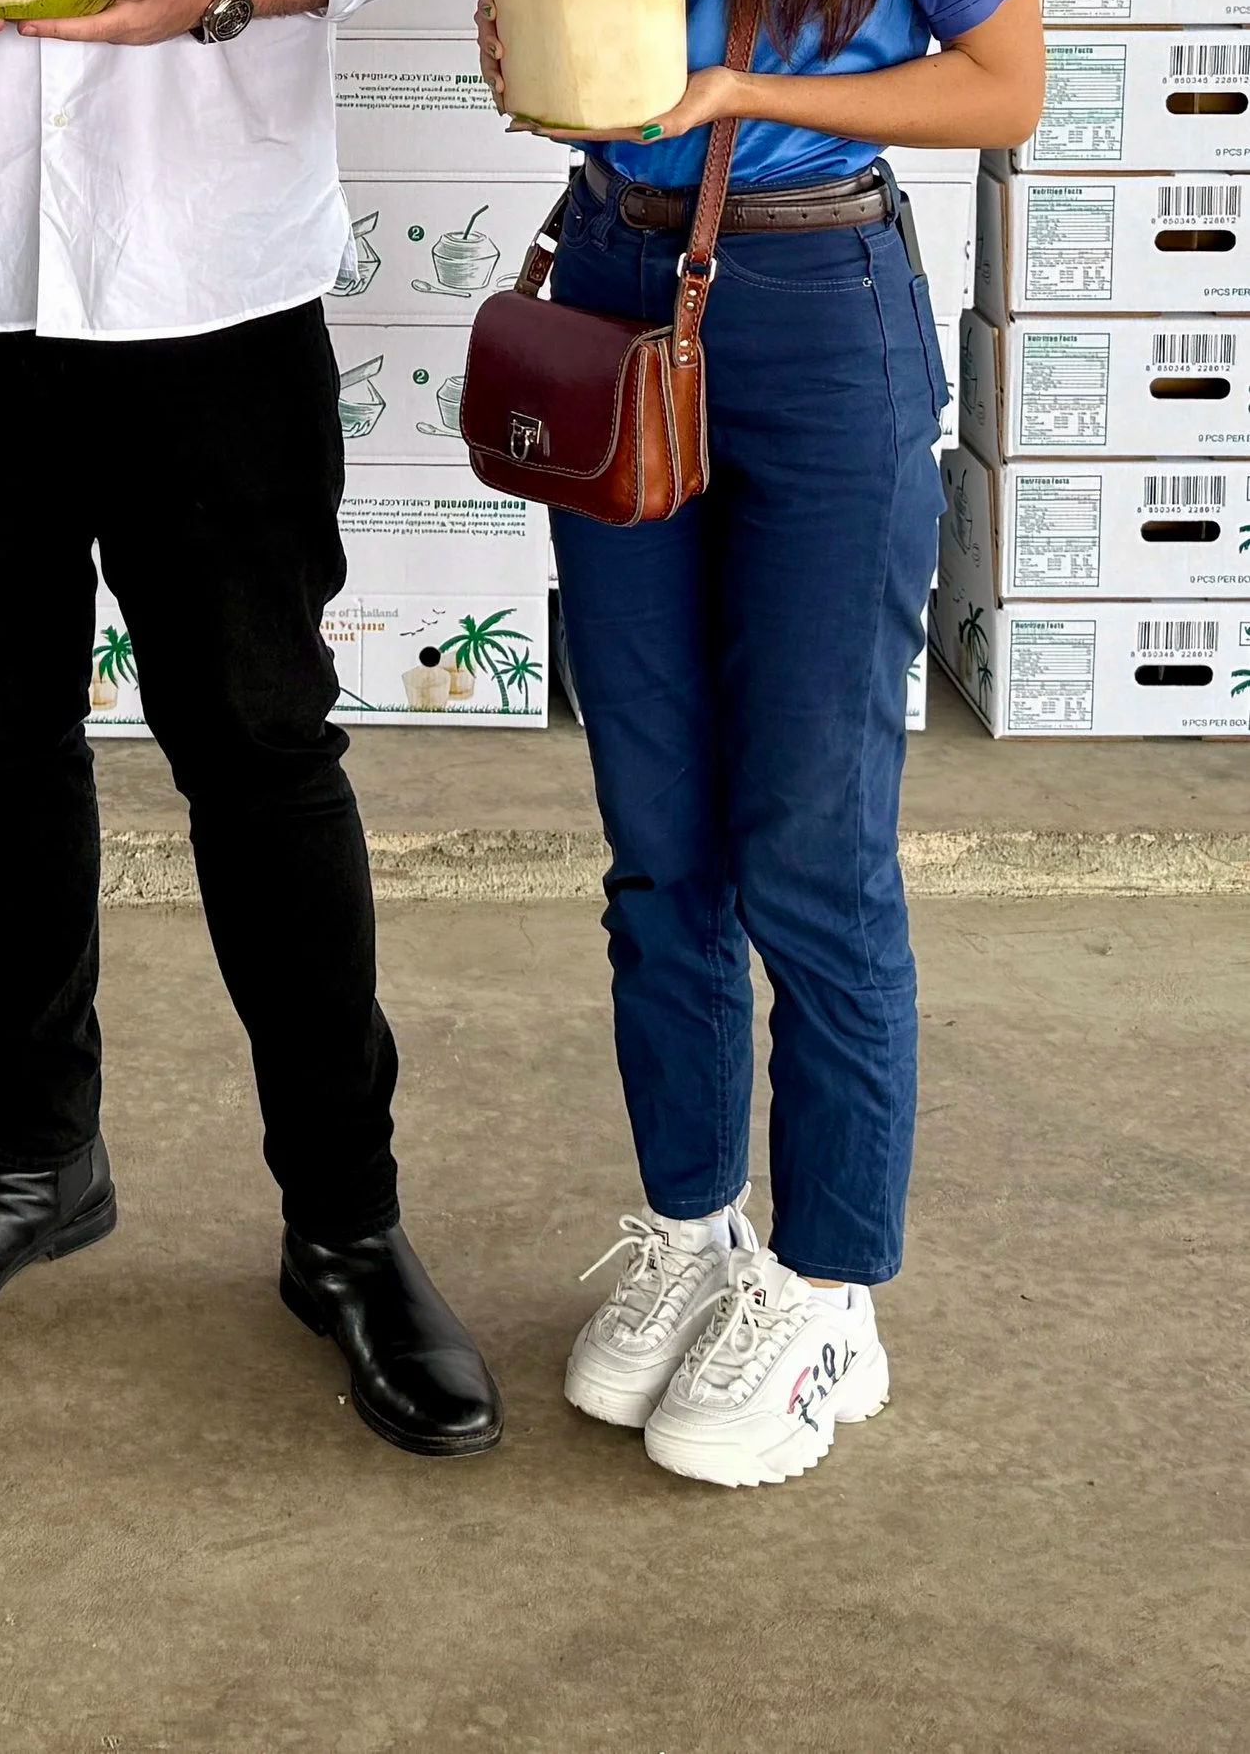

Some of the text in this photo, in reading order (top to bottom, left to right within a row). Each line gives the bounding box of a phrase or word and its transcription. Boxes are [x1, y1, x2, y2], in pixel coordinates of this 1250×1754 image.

[1226, 6, 1232, 14] 9
[1074, 46, 1093, 54] Facts
[1174, 76, 1208, 84] 850345
[1215, 148, 1242, 156] 9 PCS
[1204, 288, 1210, 296] 9
[434, 500, 526, 510] Keep Refrigerated
[339, 609, 398, 617] of Thailand
[340, 621, 384, 630] Young
